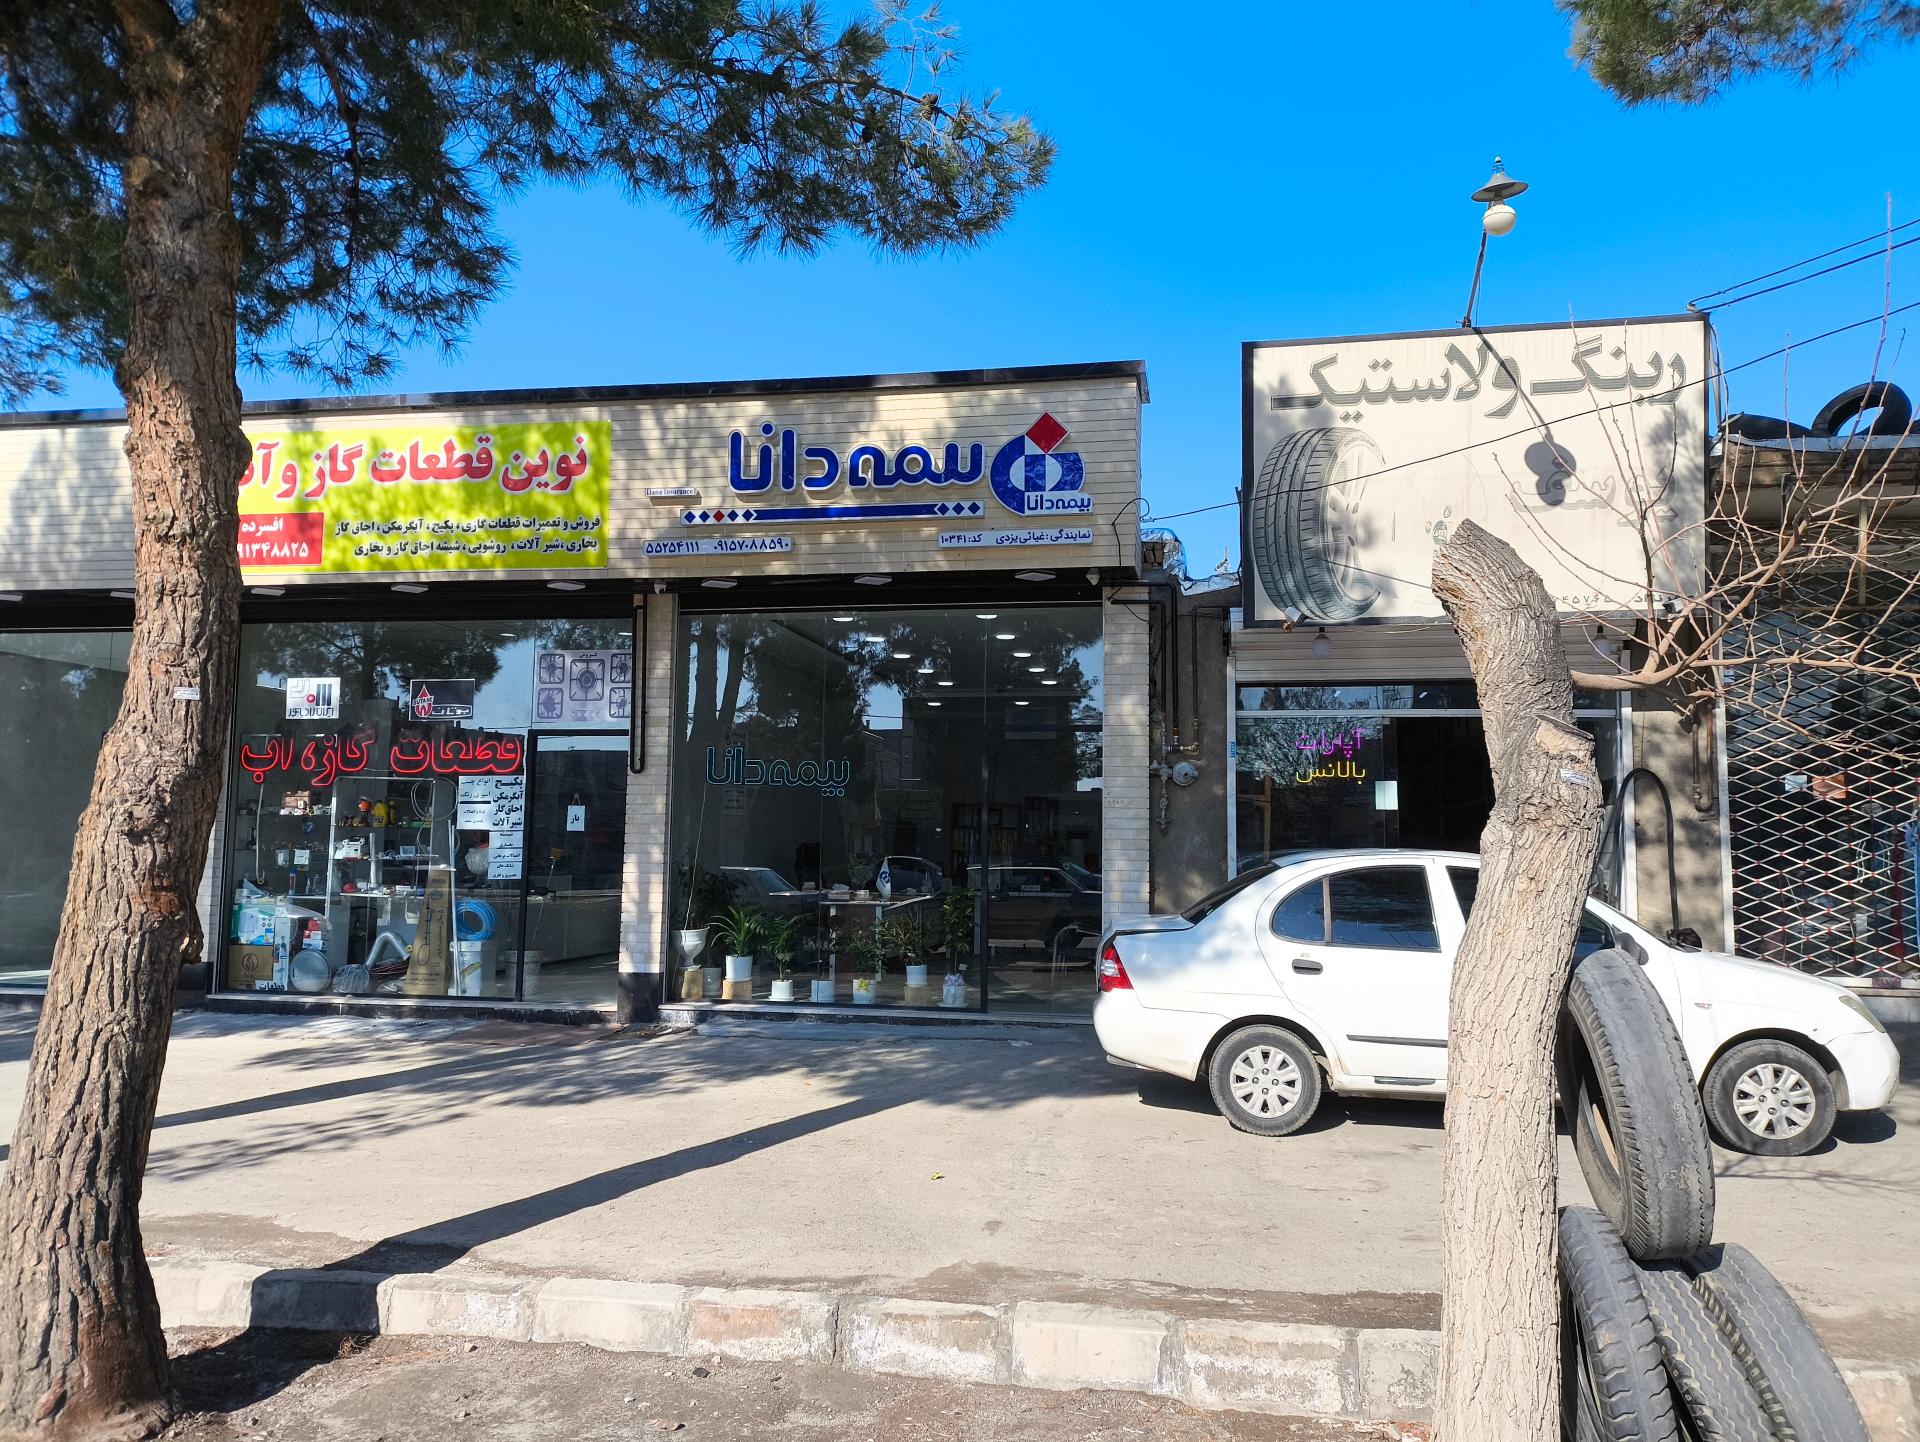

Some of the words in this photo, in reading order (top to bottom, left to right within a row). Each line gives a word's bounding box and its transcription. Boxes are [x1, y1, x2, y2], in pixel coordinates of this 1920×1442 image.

[1530, 334, 1687, 407] رینگ
[1271, 340, 1491, 424] لاستیک
[370, 435, 494, 483] قطعات
[501, 435, 588, 492] نوین
[727, 421, 842, 495] دانا
[304, 443, 364, 498] گاز
[276, 463, 298, 498] و
[1026, 493, 1055, 511] دانا
[1056, 497, 1091, 512] بیمه
[241, 517, 284, 537] افسرده
[335, 521, 350, 536] گاز
[351, 521, 375, 536] اجاق
[488, 517, 521, 530] قطعات
[522, 516, 561, 532] تعمیرات
[562, 520, 569, 531] و
[571, 515, 601, 531] فروش
[354, 542, 384, 557] بخاری
[393, 541, 409, 556] گاز
[410, 541, 434, 556] اجاق
[436, 541, 460, 554] شیشه
[645, 540, 700, 554] ۵۵۲۵۴۱۱۱
[713, 537, 789, 552] ۰۹۱۵۷۰۸۸۵۹۰
[432, 706, 470, 716] بوتان
[1295, 727, 1367, 758] آپارات
[705, 746, 766, 785] دانا
[1295, 760, 1367, 785] بالانس
[768, 759, 851, 797] بیمه
